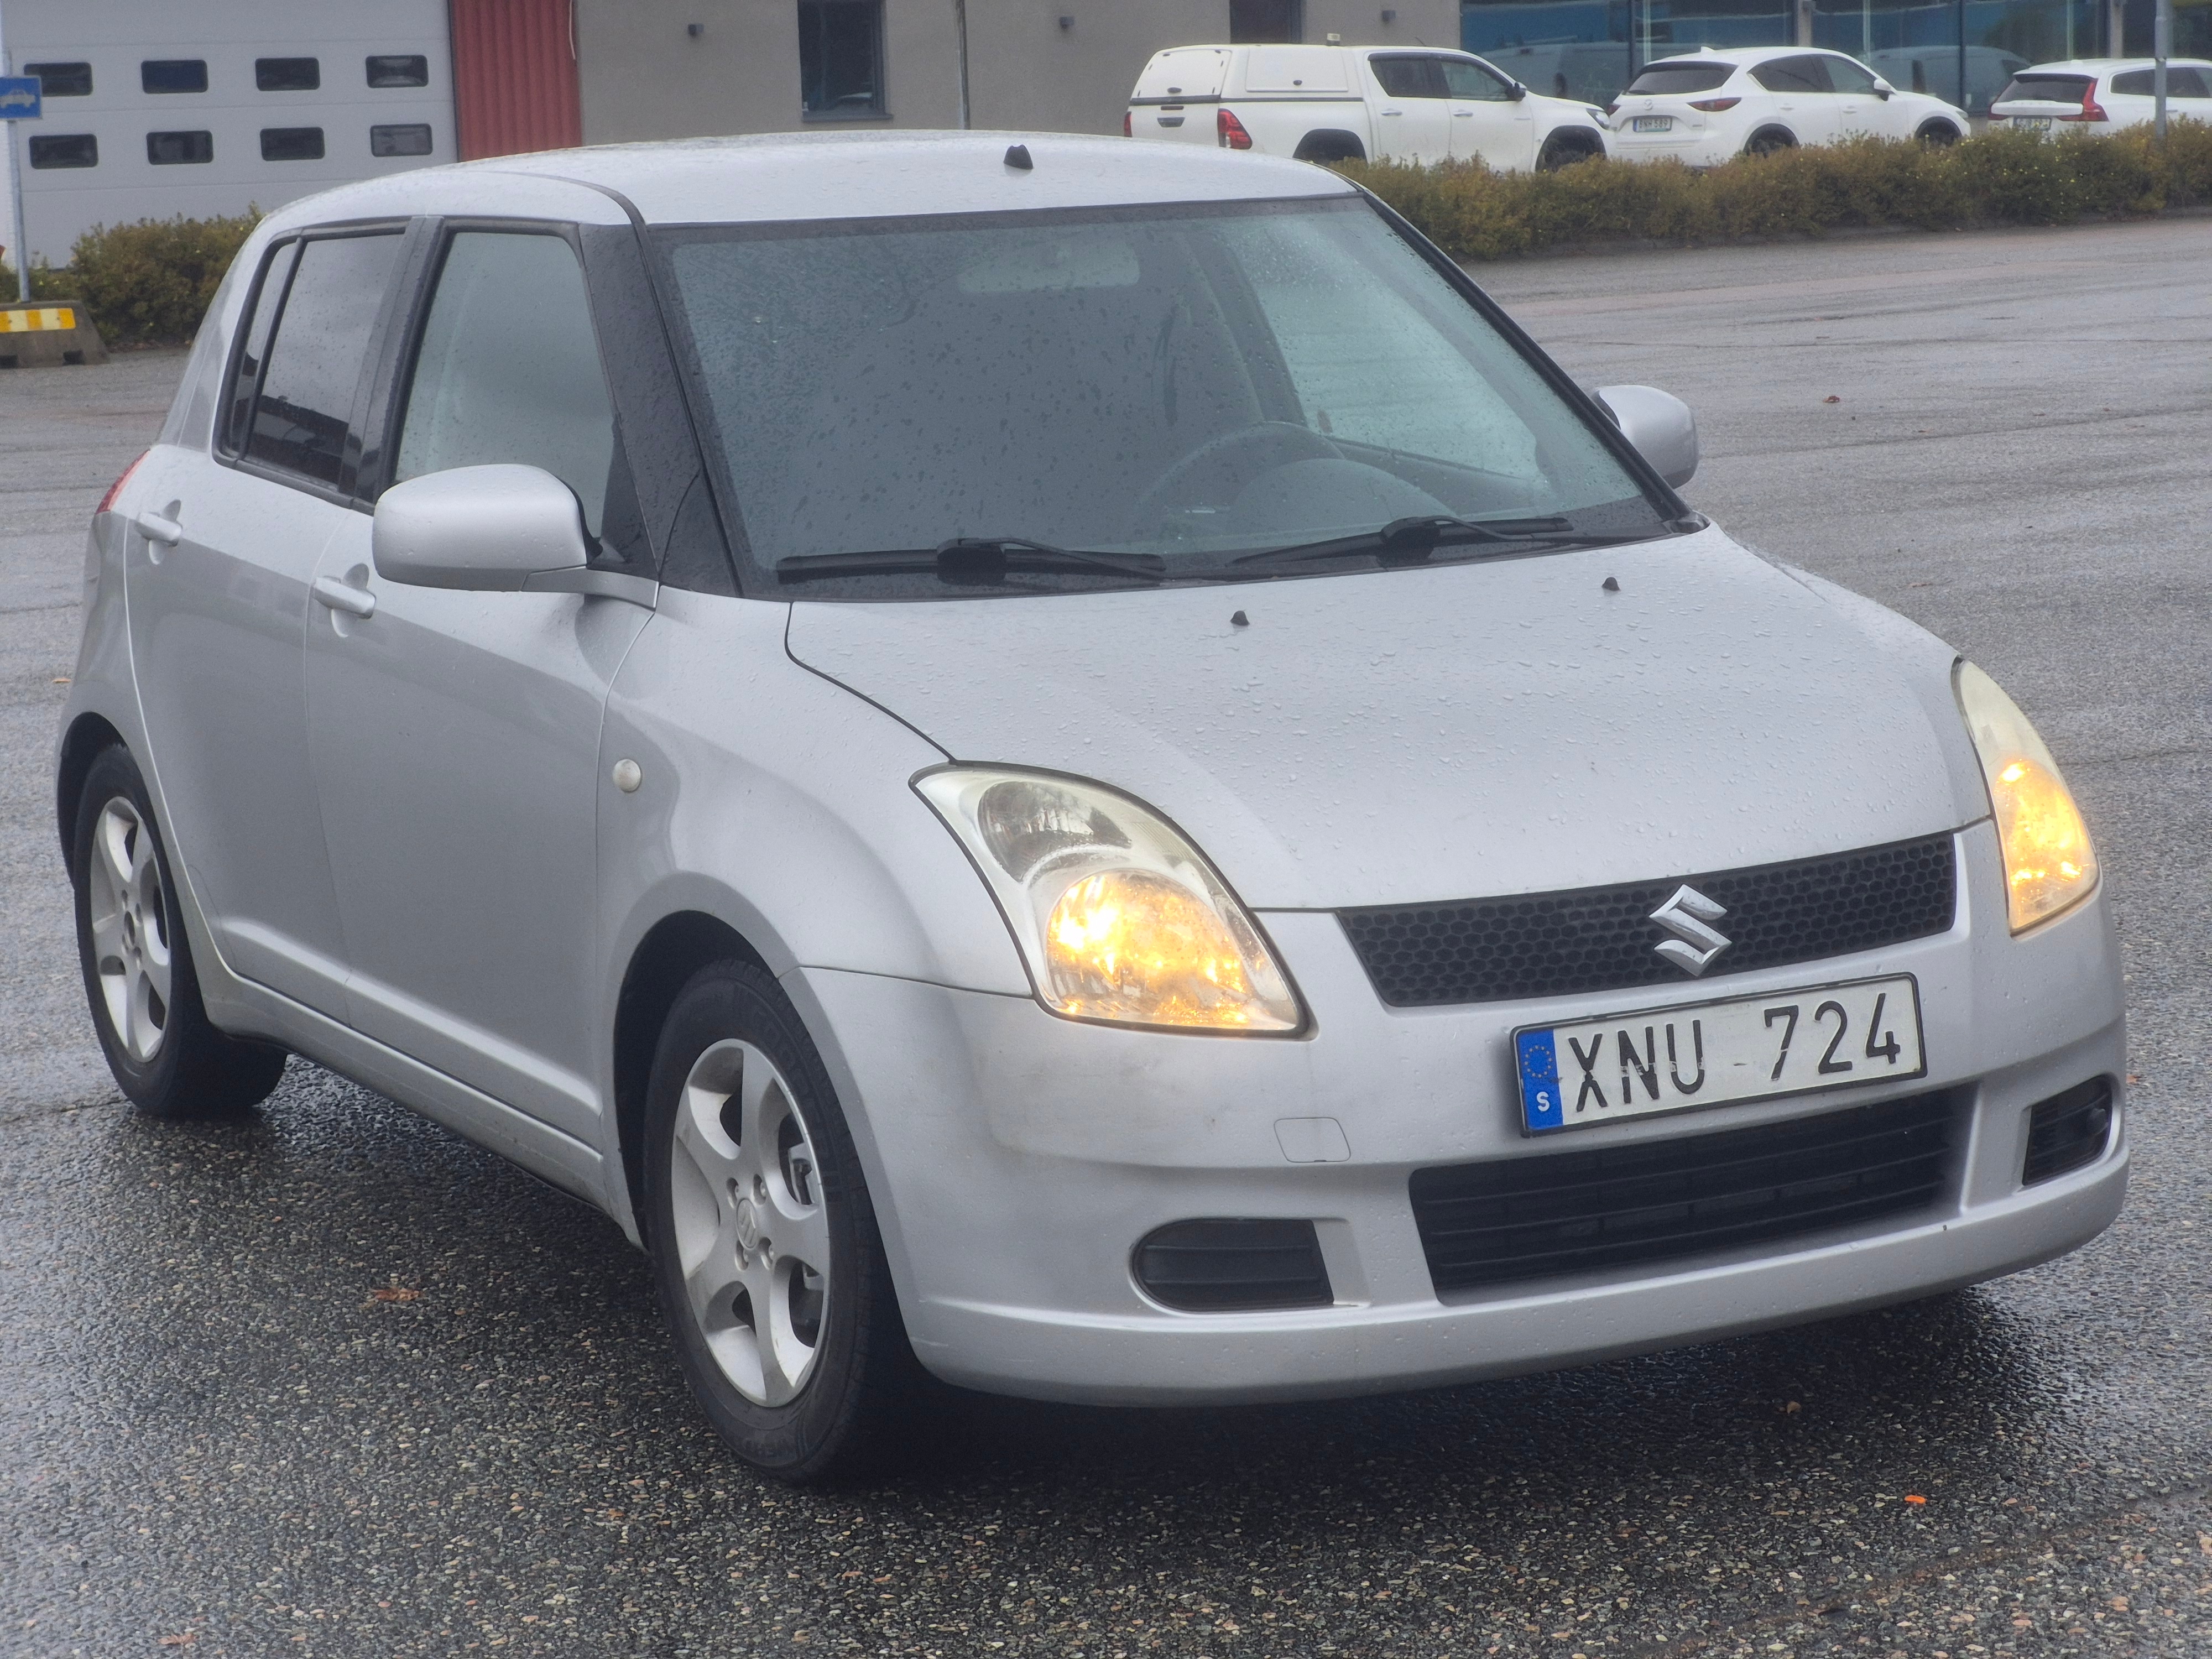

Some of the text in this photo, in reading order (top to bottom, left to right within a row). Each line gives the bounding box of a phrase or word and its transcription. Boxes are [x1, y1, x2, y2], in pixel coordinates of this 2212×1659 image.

[1568, 993, 1901, 1113] XNU 724
[1537, 1091, 1550, 1112] S
